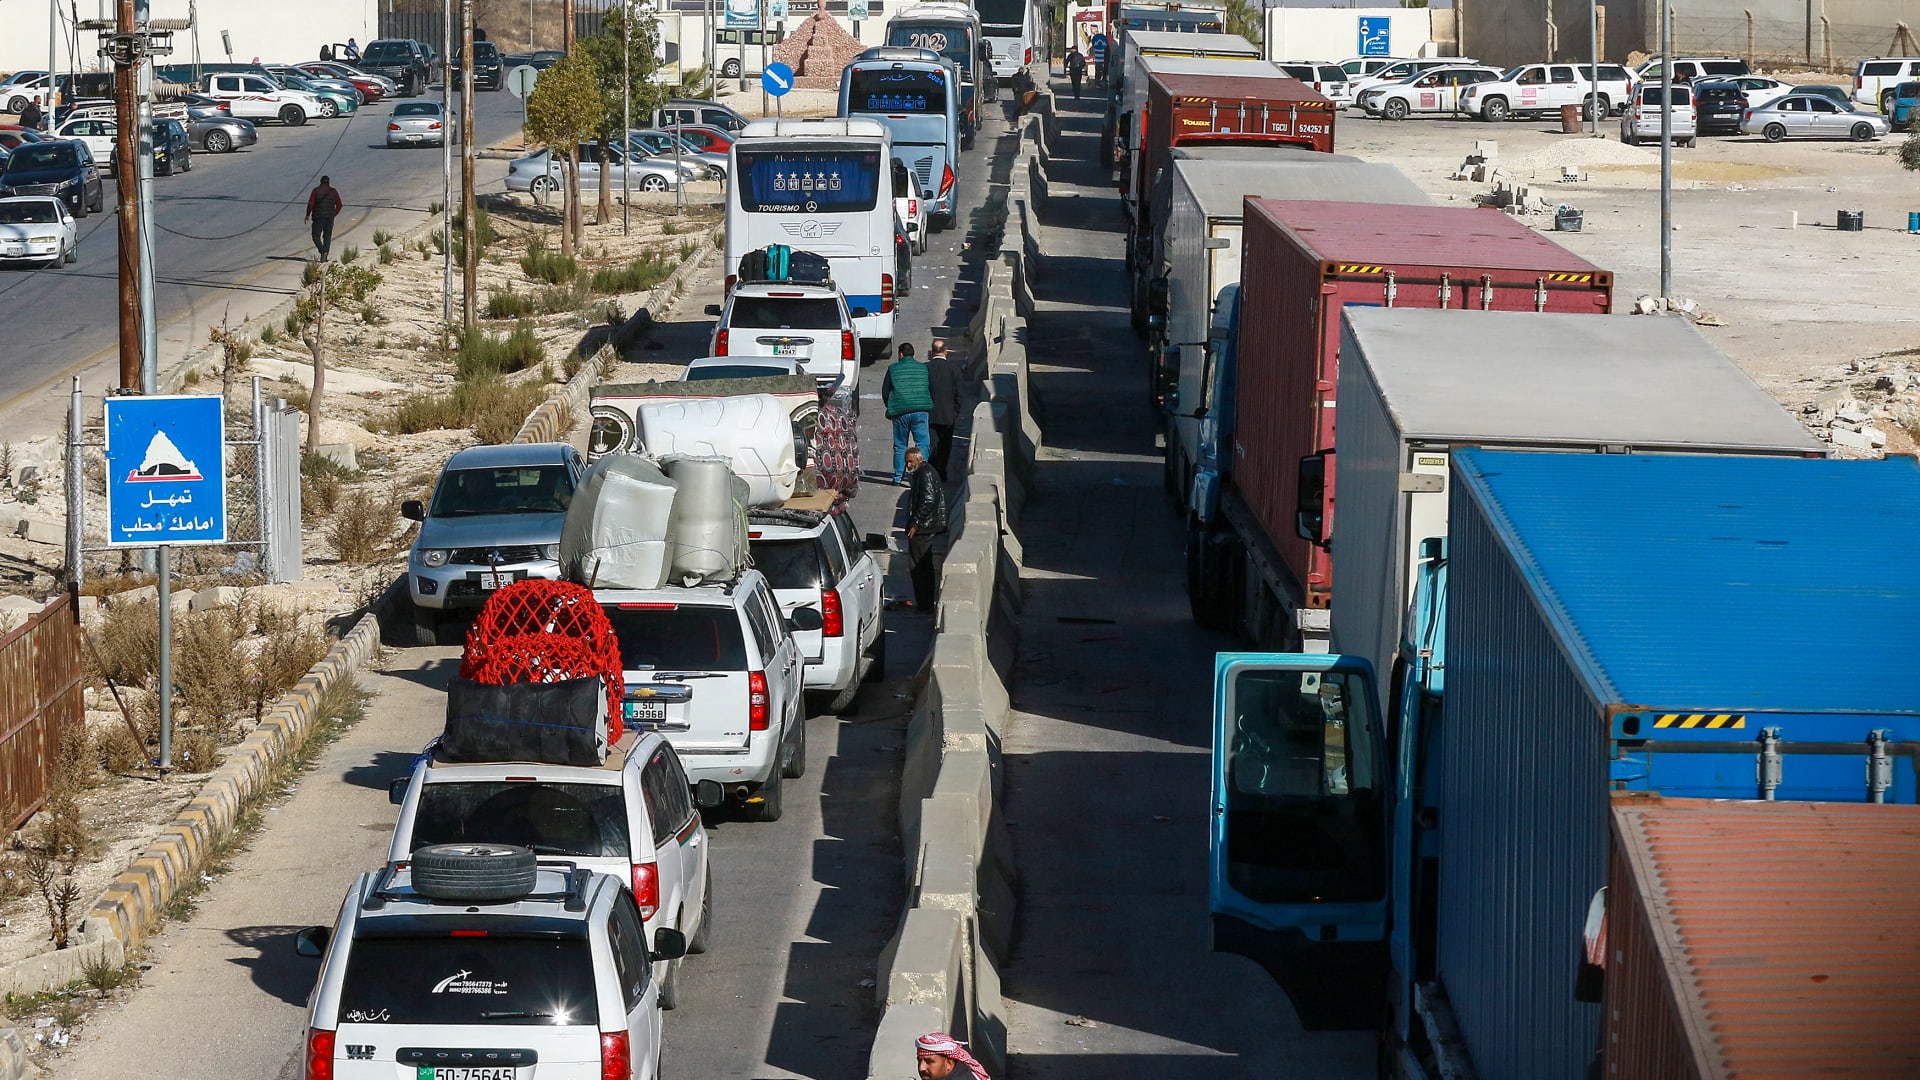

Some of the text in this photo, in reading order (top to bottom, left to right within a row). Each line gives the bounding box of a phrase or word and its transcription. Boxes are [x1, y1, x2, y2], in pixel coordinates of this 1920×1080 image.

[1271, 123, 1288, 132] TGCU
[1299, 124, 1322, 134] 524252
[758, 204, 800, 212] TOURISMO
[140, 489, 193, 509] تمهل
[642, 701, 655, 710] 50
[633, 710, 664, 719] 39968
